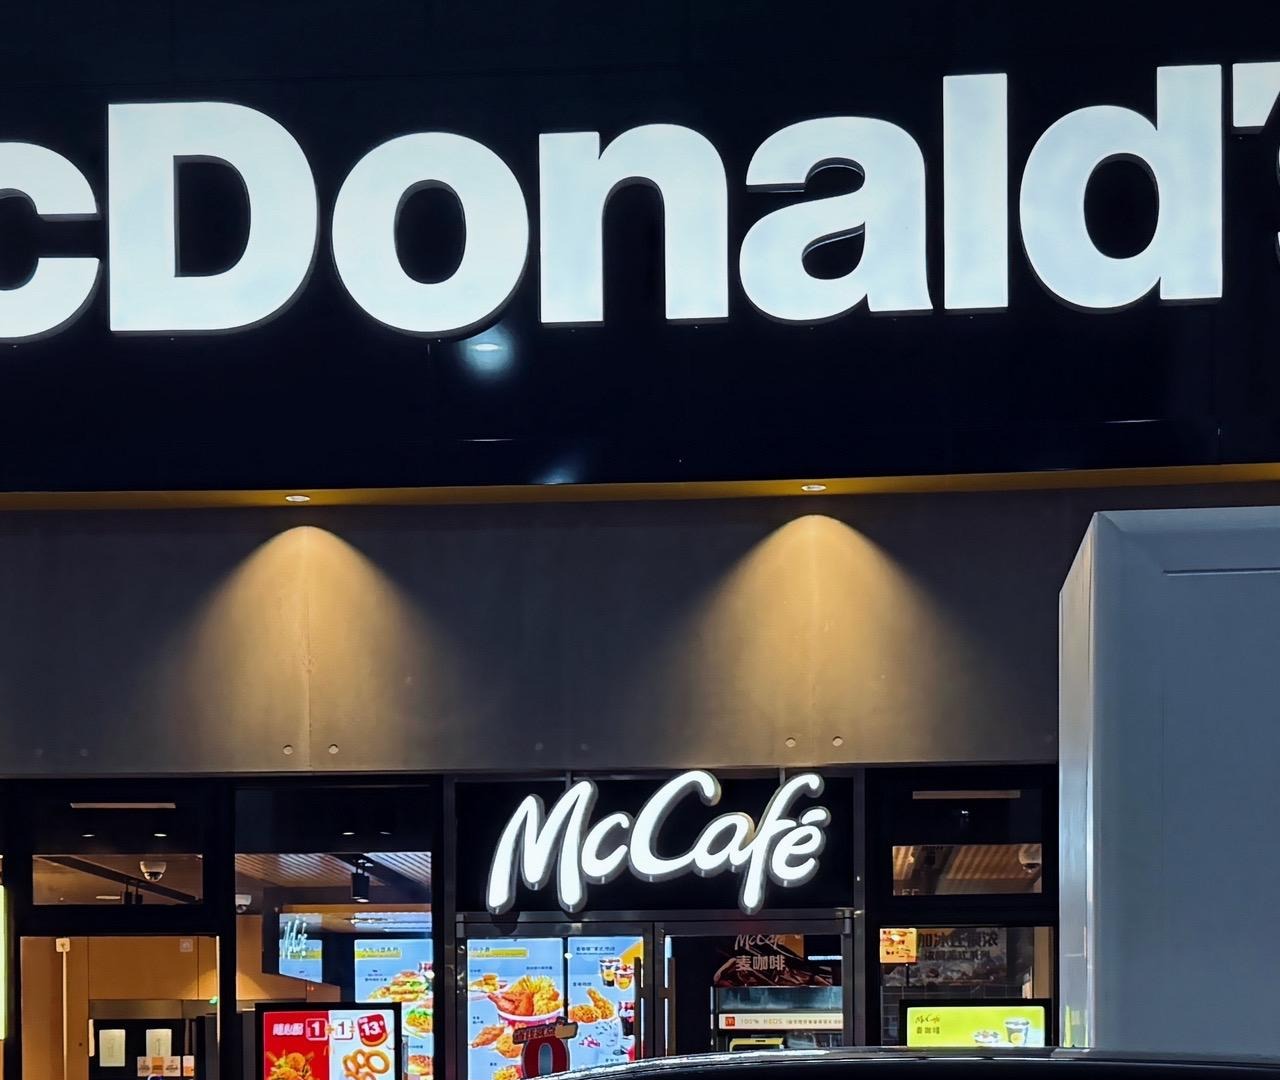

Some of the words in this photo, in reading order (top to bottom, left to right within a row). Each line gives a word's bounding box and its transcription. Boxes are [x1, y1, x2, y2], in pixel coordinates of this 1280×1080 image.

[487, 769, 828, 912] McCafé
[735, 955, 787, 971] 麦咖啡
